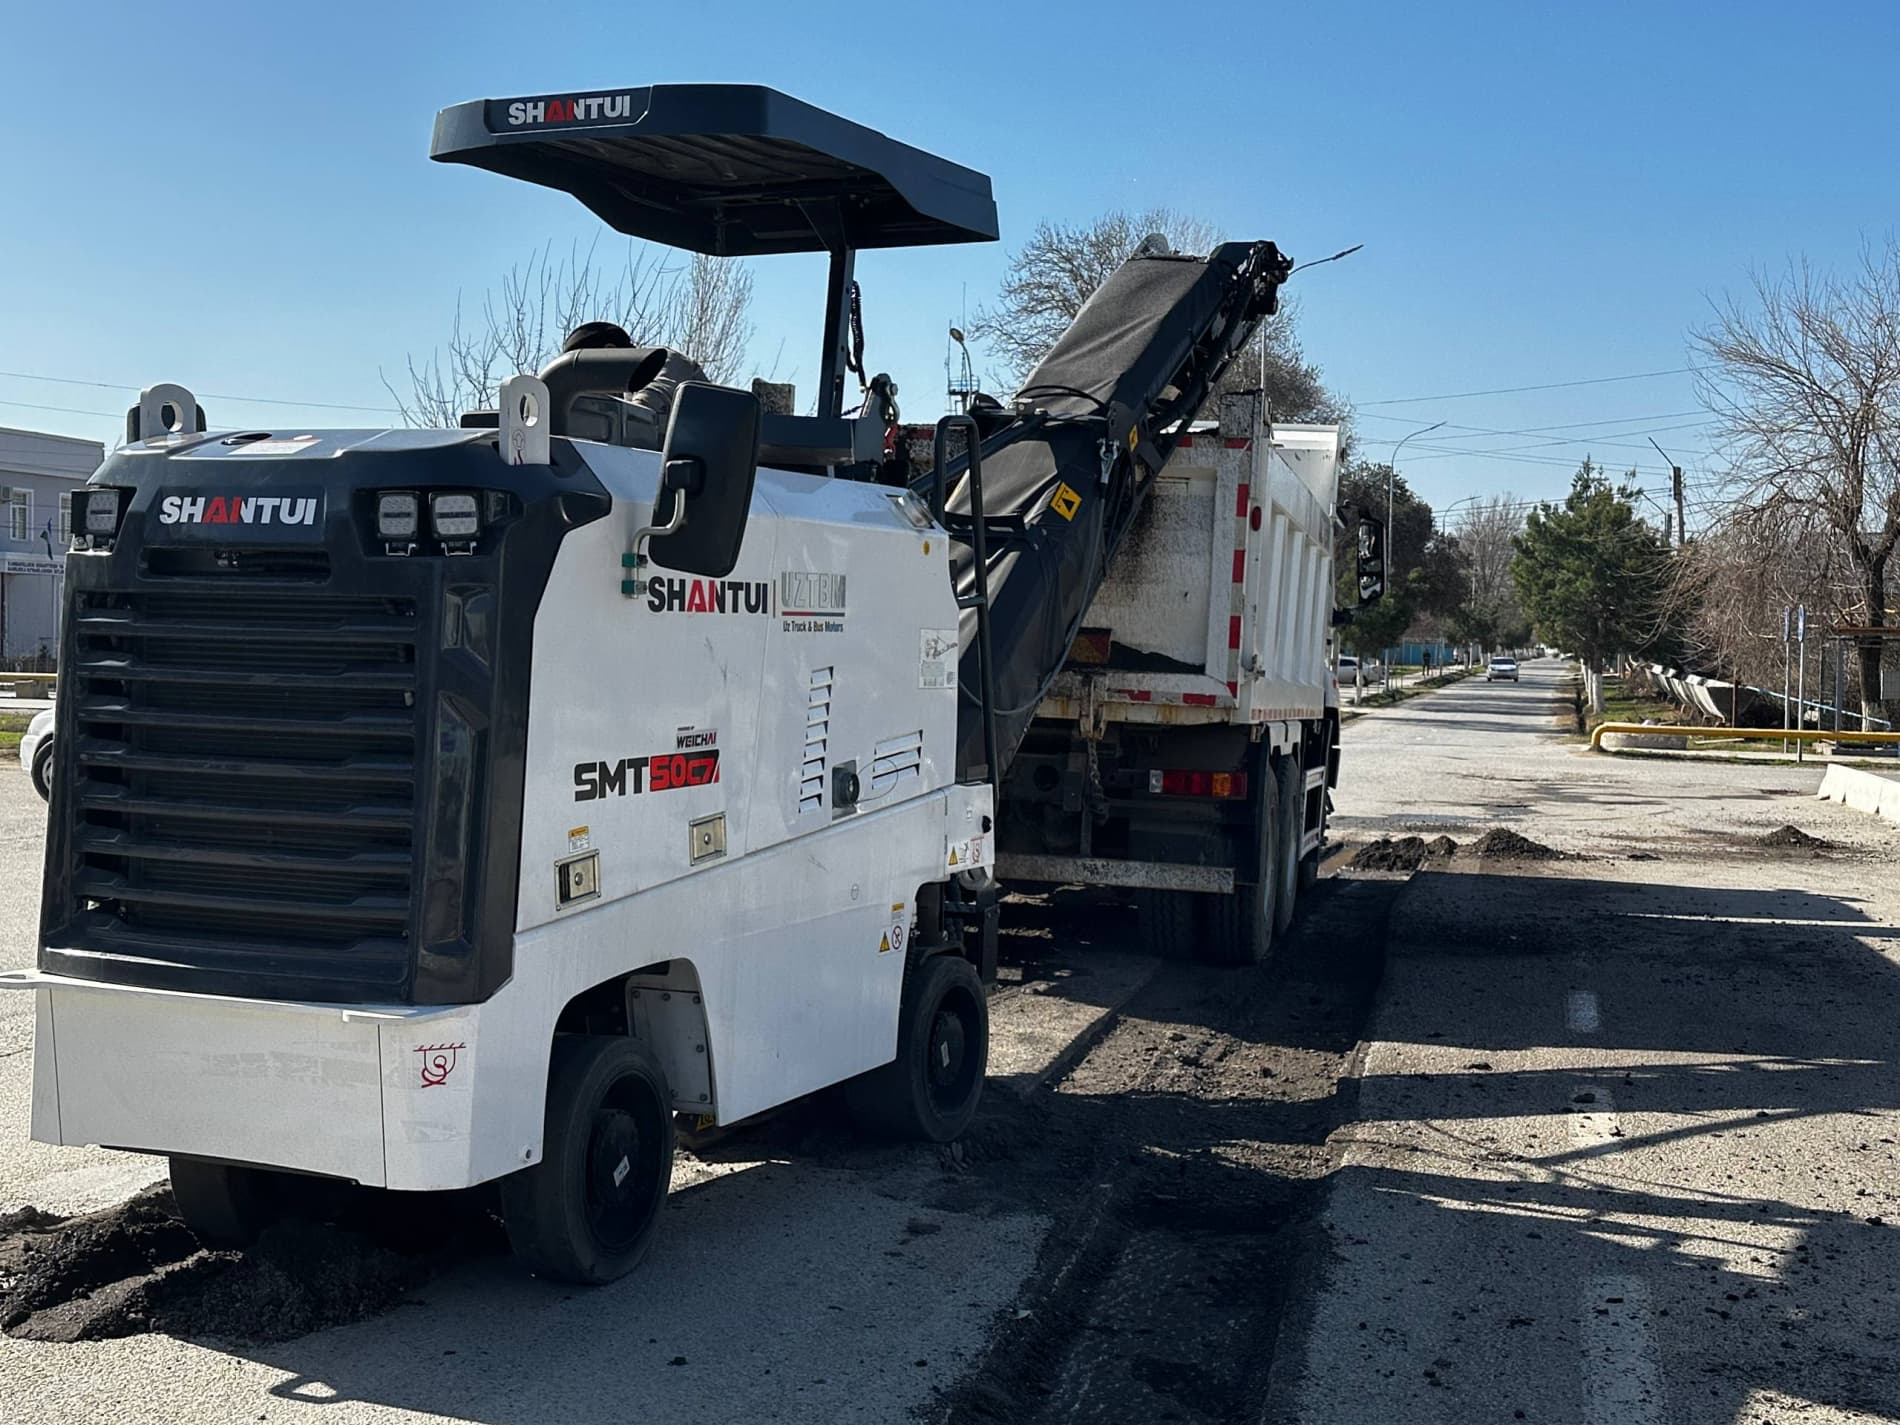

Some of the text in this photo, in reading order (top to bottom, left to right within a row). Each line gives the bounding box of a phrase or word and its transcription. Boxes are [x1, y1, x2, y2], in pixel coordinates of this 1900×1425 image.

[508, 95, 631, 125] SHANTUI
[159, 495, 318, 525] SHANTUI
[647, 576, 768, 614] SHANTUI
[781, 571, 847, 609] UZTBM
[783, 620, 791, 632] Uz
[791, 620, 806, 632] Truck
[808, 620, 813, 632] &
[824, 620, 843, 632] Motors
[676, 732, 717, 749] WEICHAI
